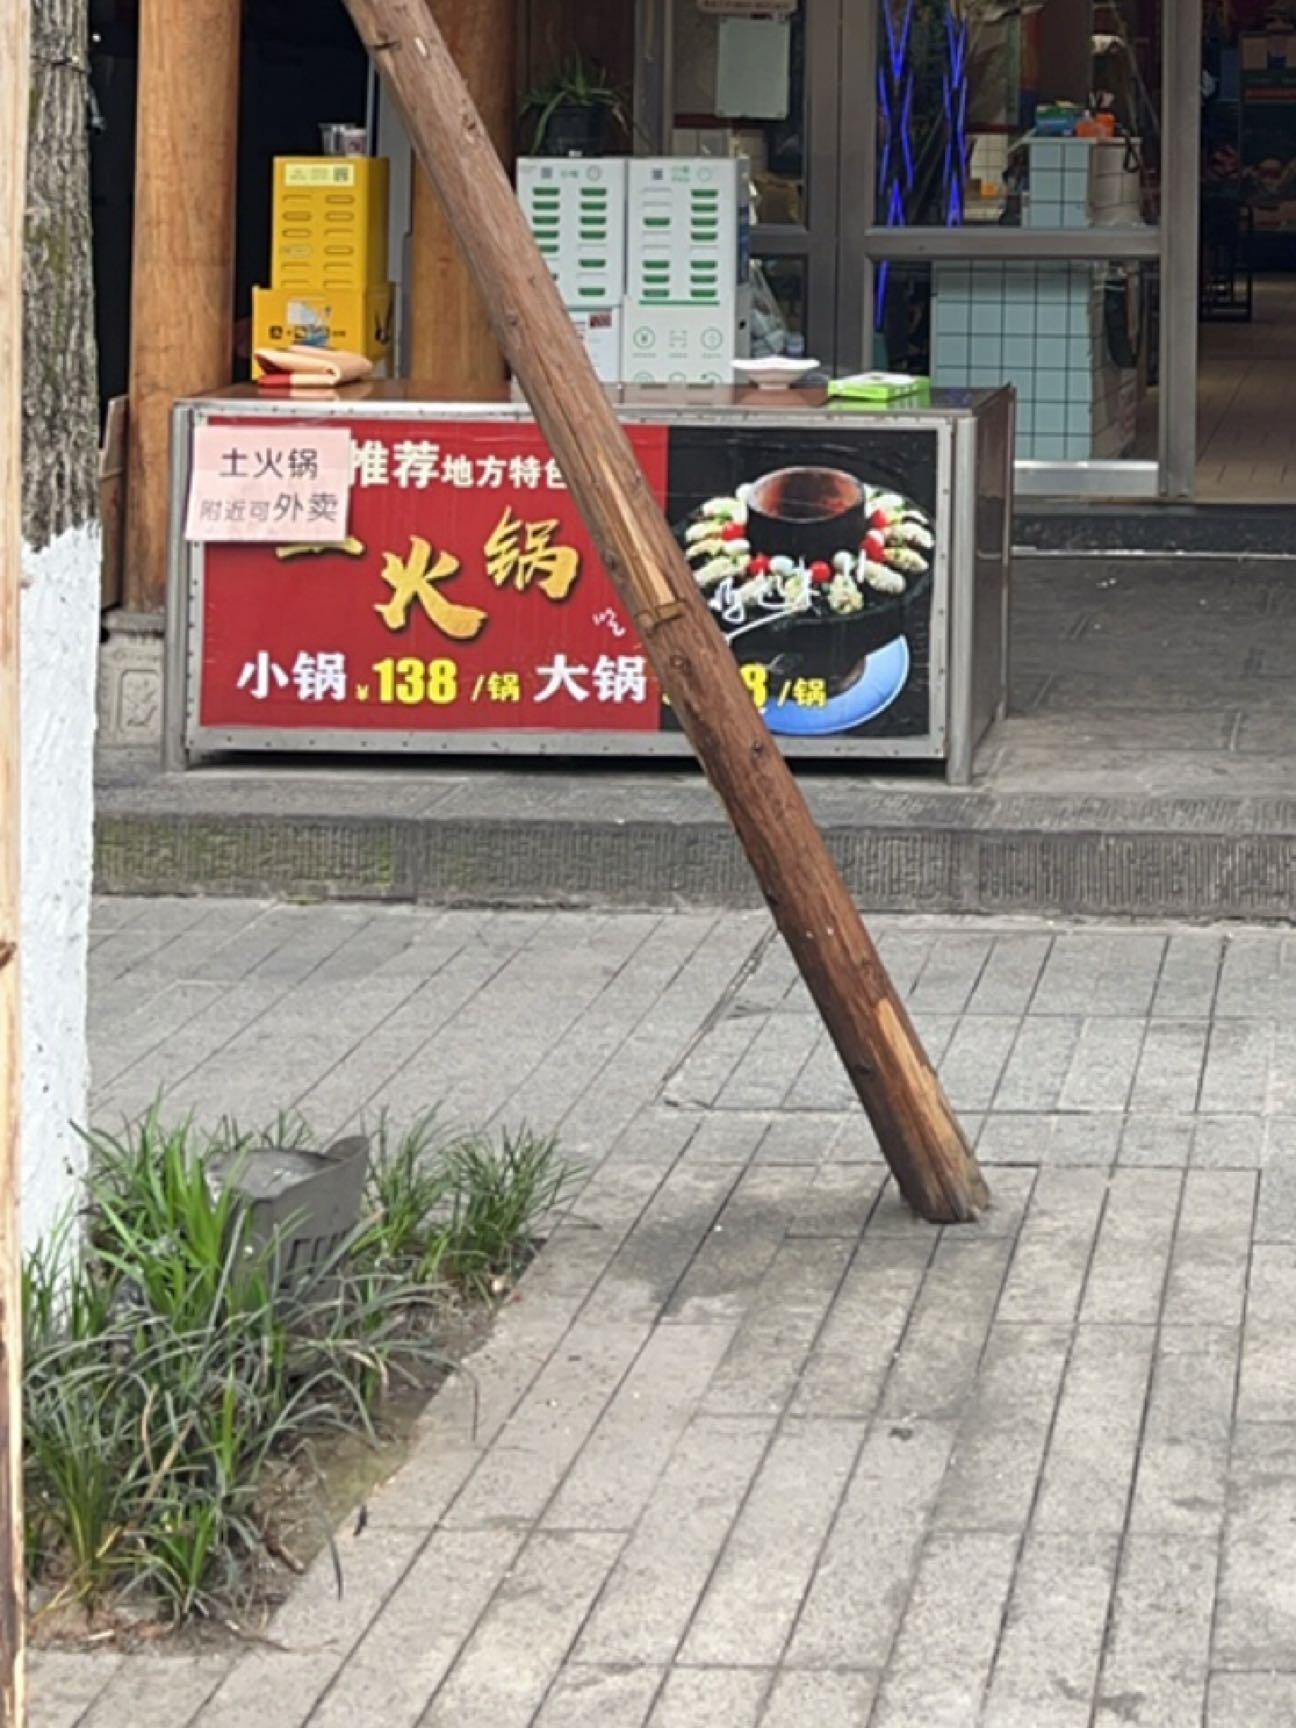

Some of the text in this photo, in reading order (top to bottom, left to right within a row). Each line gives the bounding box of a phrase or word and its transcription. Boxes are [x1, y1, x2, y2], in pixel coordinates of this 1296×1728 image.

[218, 446, 319, 480] 土火锅
[198, 491, 338, 522] 附近可外卖
[236, 650, 347, 701] 小锅
[533, 654, 648, 704] 大锅
